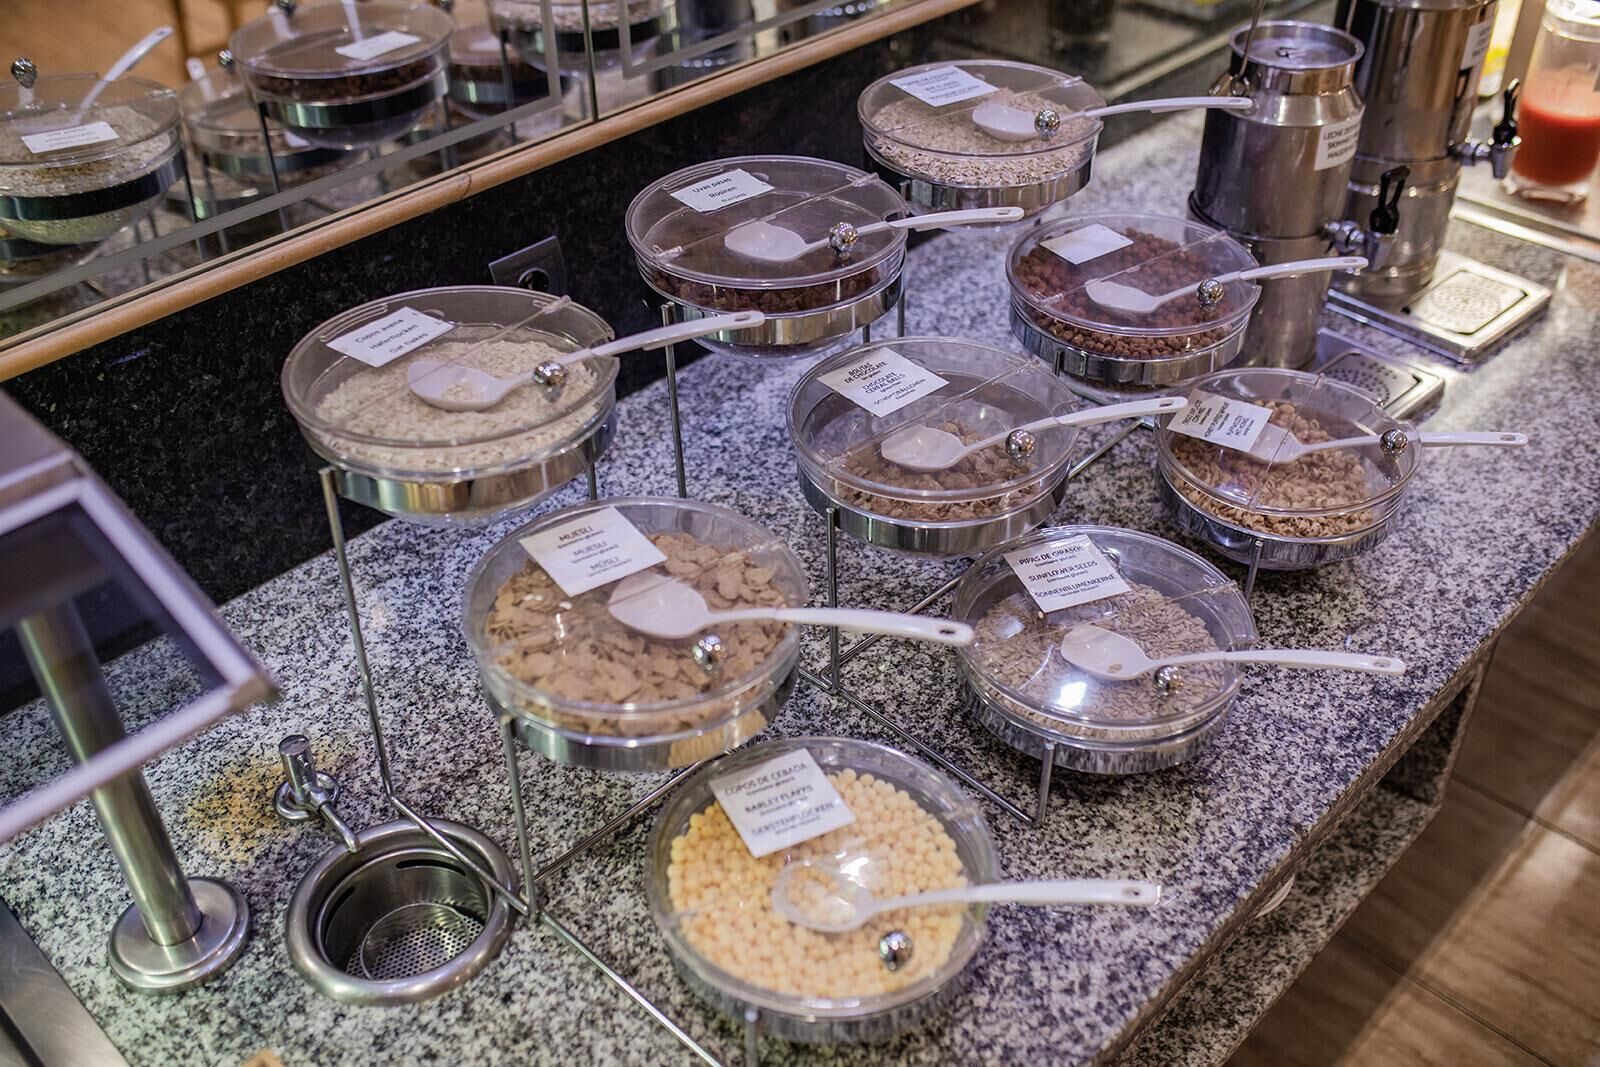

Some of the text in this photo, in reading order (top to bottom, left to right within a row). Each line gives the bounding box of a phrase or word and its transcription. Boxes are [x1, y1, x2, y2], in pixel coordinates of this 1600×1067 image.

[691, 177, 732, 193] Uvas pasas
[708, 186, 737, 198] Rosinen
[381, 319, 404, 332] avena
[843, 361, 888, 384] DE CHOCOLATE
[848, 362, 873, 377] BOLITAS
[862, 371, 897, 390] CHOCOLATE
[865, 382, 889, 394] CEREAL
[885, 373, 905, 384] BALLS
[558, 526, 593, 542] MUESLI
[572, 541, 608, 556] MUESLI
[1019, 546, 1082, 565] PIPAS DE GIRASOL
[1028, 560, 1098, 582] SUNFLOWER SEEDS
[724, 763, 807, 796] COPOS DE CEBADA
[744, 796, 779, 813] BARLEY
